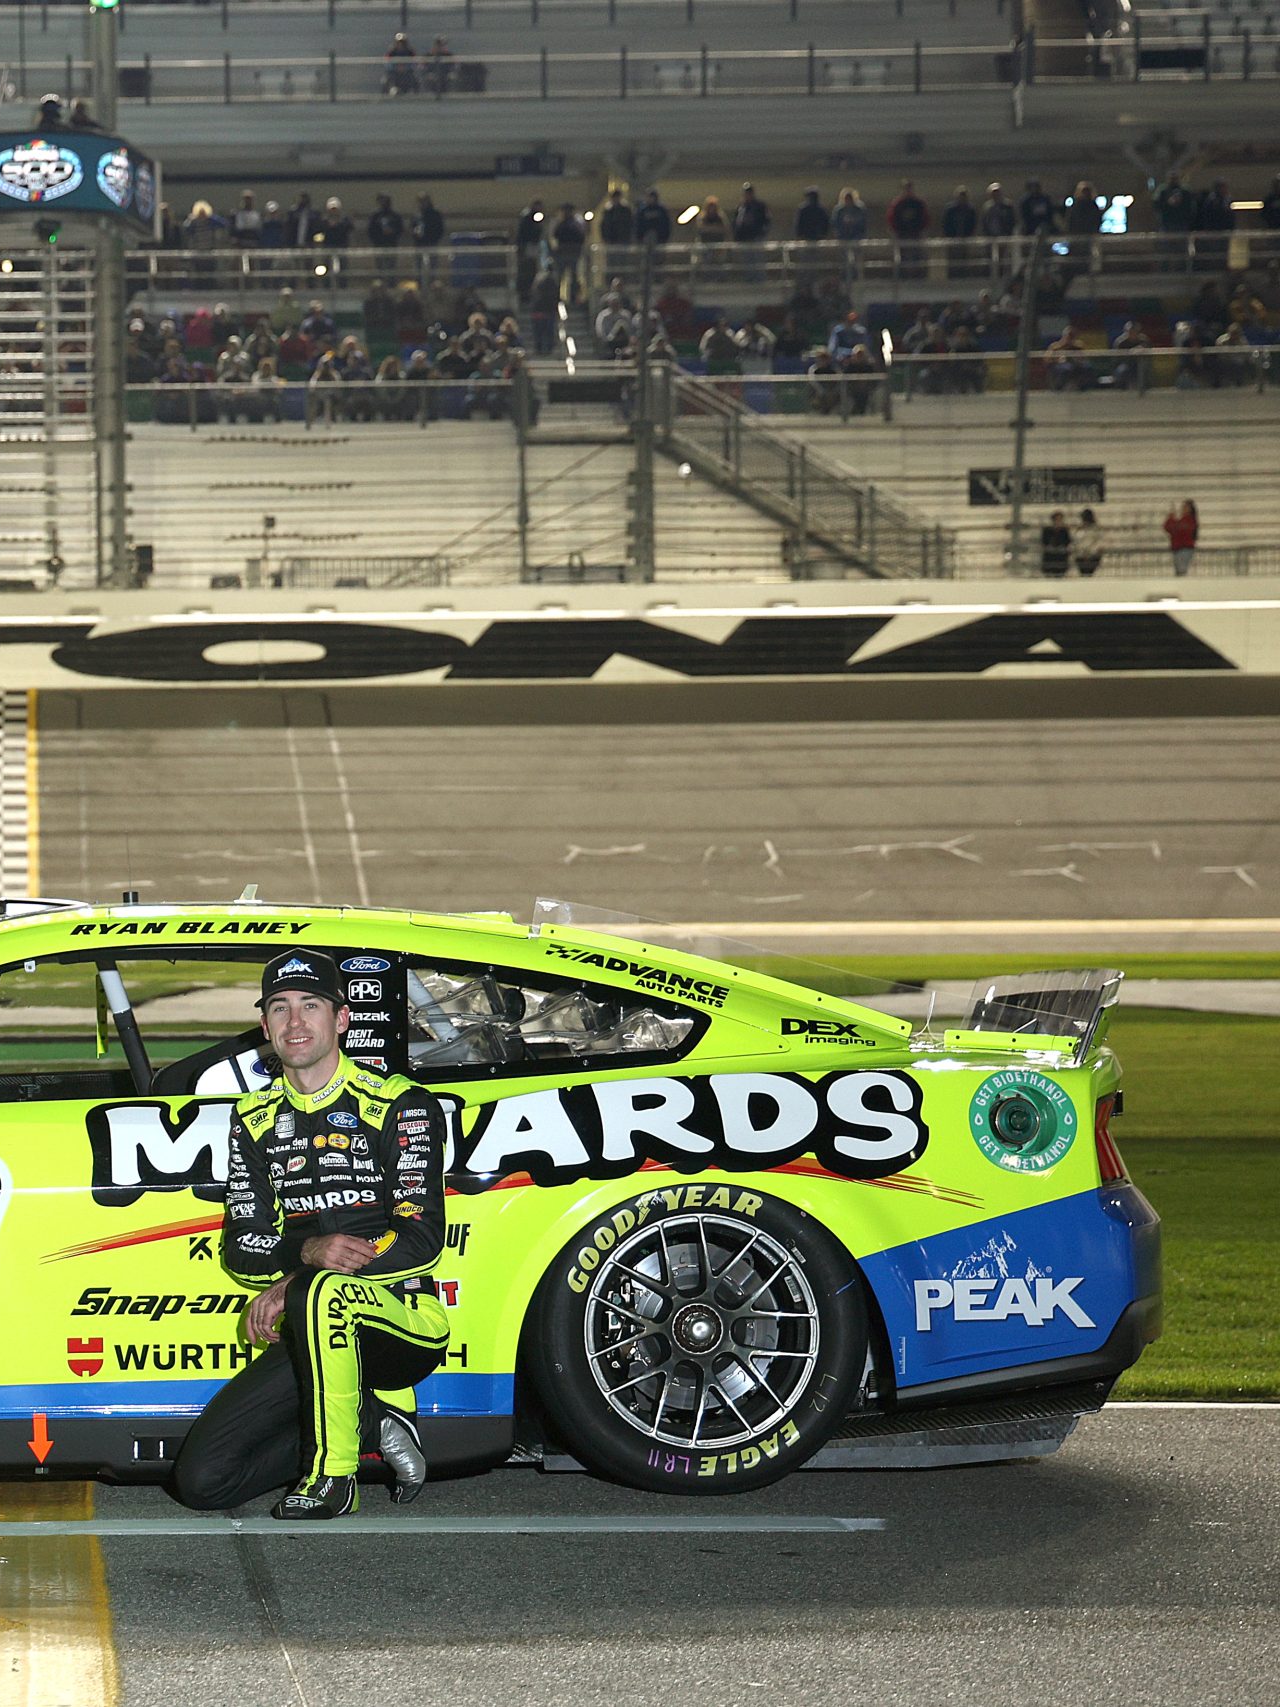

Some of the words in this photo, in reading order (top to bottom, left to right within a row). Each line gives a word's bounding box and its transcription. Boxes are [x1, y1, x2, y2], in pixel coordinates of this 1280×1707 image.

[71, 922, 167, 935] RYAN
[176, 922, 311, 934] BLANEY
[278, 963, 312, 977] PEAK
[349, 958, 380, 970] Ford
[273, 974, 319, 983] PERFORMANCE
[582, 953, 729, 1001] ADVANCE
[351, 982, 380, 1000] PPG
[635, 979, 675, 994] AUTO
[677, 989, 723, 1008] PARTS
[347, 1029, 373, 1038] DENT
[781, 1018, 861, 1037] DEX
[345, 1038, 385, 1048] WIZARD
[805, 1035, 876, 1046] imaging
[976, 1084, 993, 1106] GET
[993, 1071, 1067, 1109] BIOETHANOL
[105, 1071, 920, 1187] MARDS
[979, 1135, 999, 1156] GET
[1000, 1134, 1071, 1169] BOETHANOL
[397, 1160, 428, 1170] WIZARD
[356, 1174, 383, 1183] MOEN
[280, 1189, 376, 1212] MENARDS
[403, 1187, 428, 1197] KIDDE
[567, 1185, 762, 1293] GOODYEAR
[70, 1287, 249, 1321] Snap-on
[914, 1277, 1096, 1331] PEAK
[114, 1344, 253, 1370] WÜRTH
[698, 1419, 801, 1477] EAGLE
